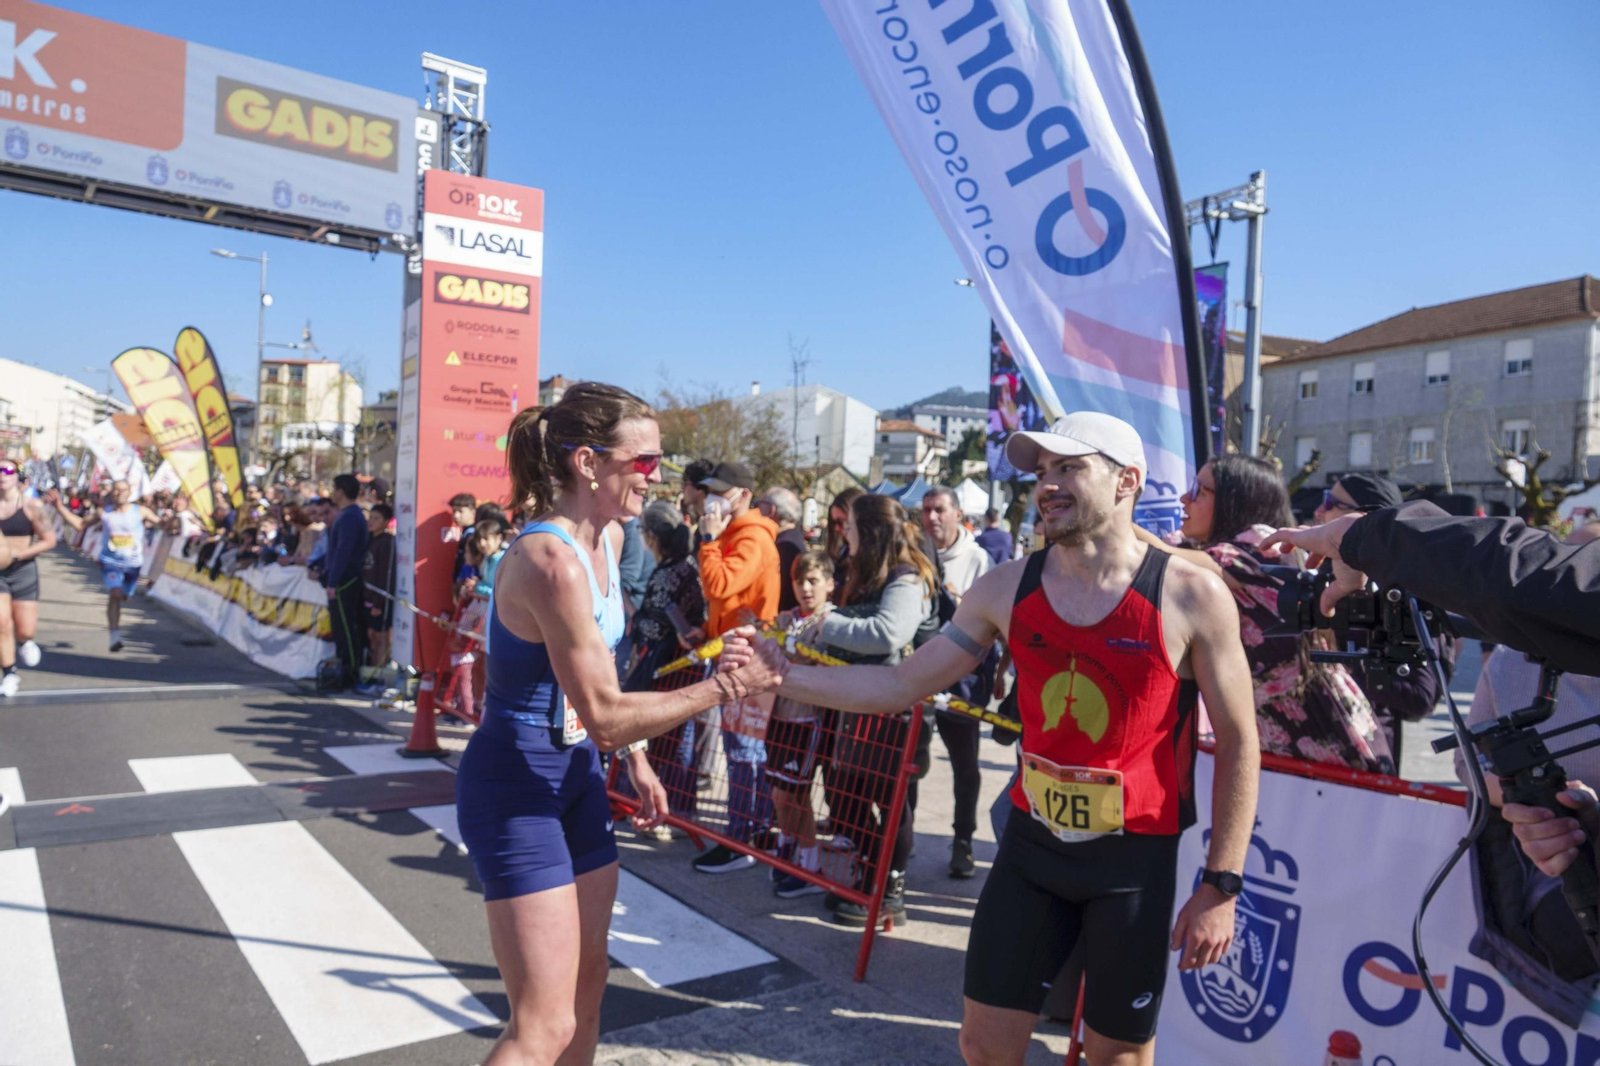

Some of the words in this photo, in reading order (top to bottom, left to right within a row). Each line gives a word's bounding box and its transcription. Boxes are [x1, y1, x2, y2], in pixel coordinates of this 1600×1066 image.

[226, 88, 394, 162] GADIS
[478, 193, 522, 217] 10K.
[460, 228, 532, 259] LASAL
[438, 275, 529, 309] GADIS
[456, 321, 503, 334] RODOSA
[463, 351, 518, 365] ELECPOR
[443, 394, 472, 405] Godoy
[450, 384, 478, 395] Grupo
[1045, 788, 1090, 829] 126
[1343, 941, 1422, 1027] O
